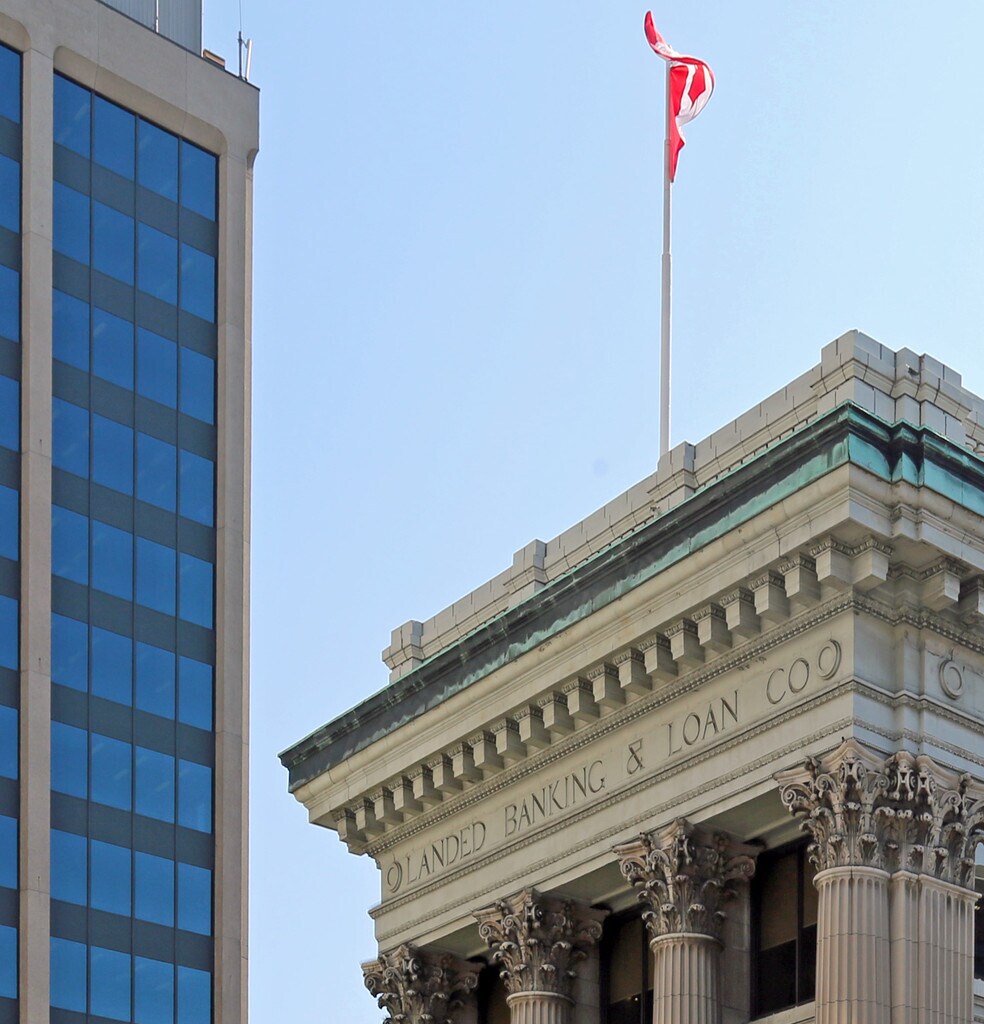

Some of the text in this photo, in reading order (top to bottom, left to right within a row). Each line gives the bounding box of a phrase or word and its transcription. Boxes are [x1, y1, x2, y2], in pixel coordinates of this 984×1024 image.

[407, 657, 810, 885] LANDED BANKING & LOAN CO
